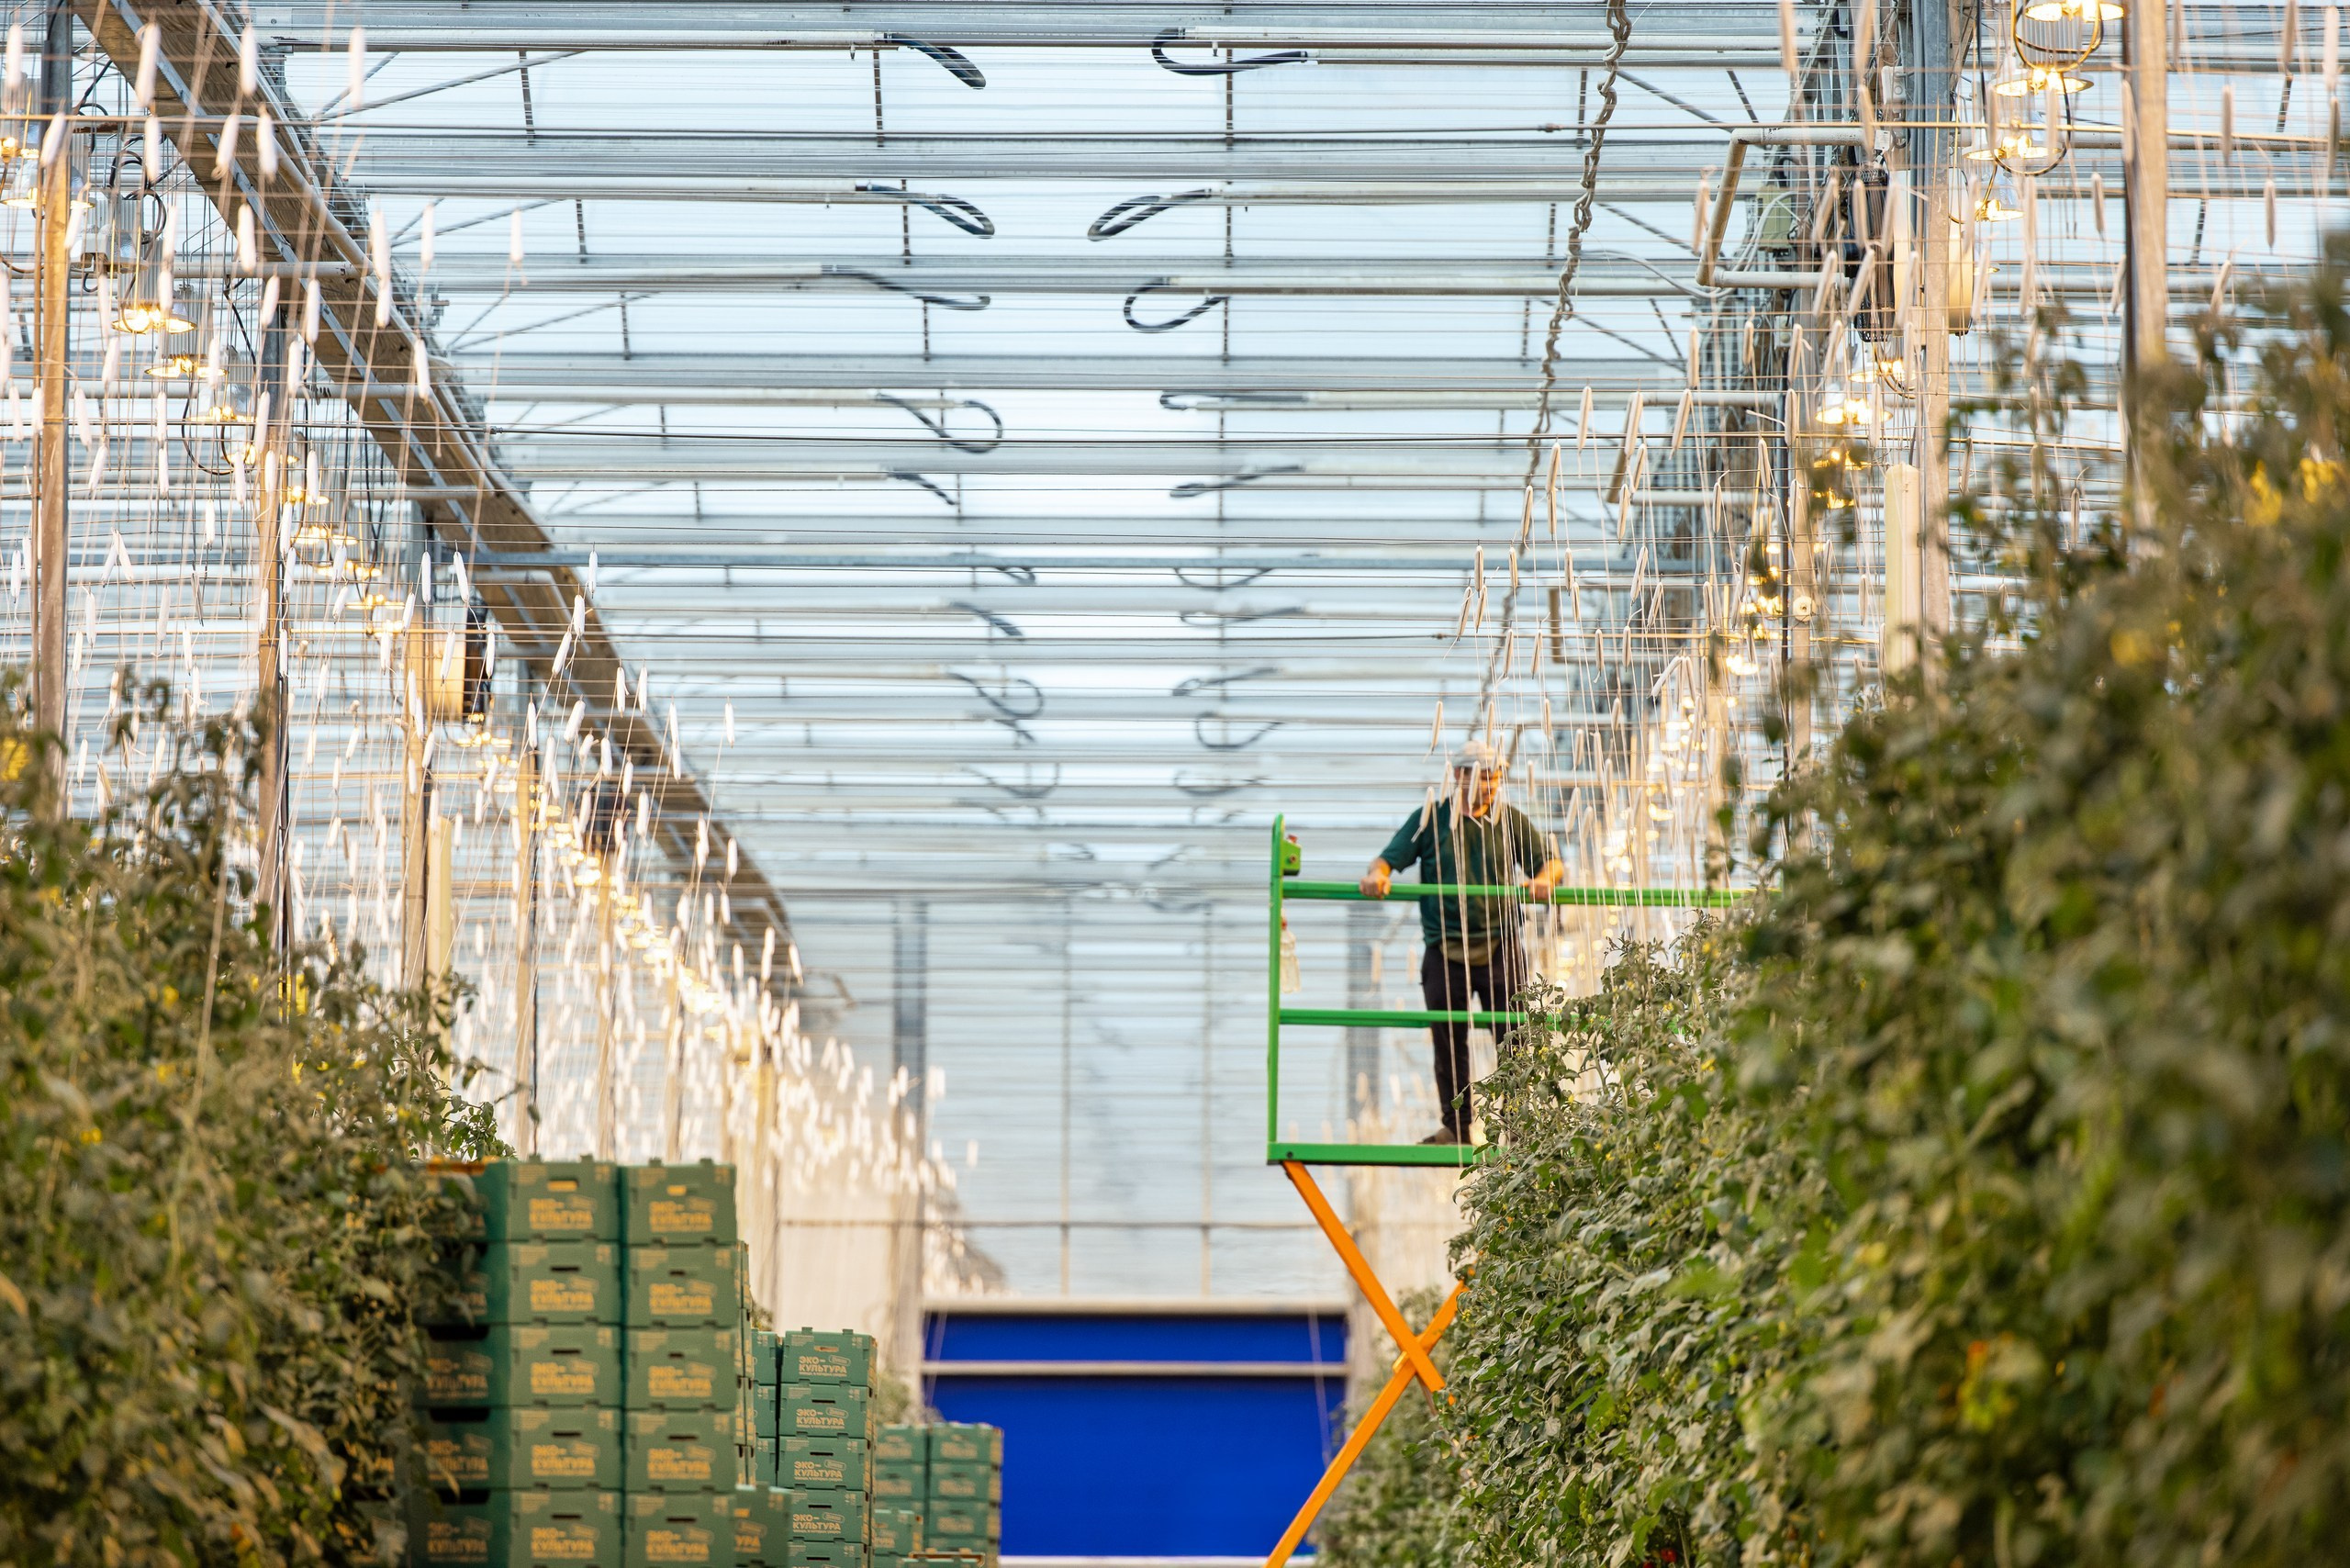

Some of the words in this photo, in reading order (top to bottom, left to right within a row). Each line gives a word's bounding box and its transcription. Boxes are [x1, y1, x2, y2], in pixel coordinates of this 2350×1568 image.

[799, 1356, 826, 1364] ЭКО-
[799, 1364, 847, 1373] КУЛЬТУРА
[796, 1408, 823, 1417] ЭКО-
[796, 1417, 845, 1426] КУЛЬТУРА
[794, 1461, 822, 1469] ЭКО-
[794, 1469, 843, 1478] КУЛЬТУРА
[792, 1521, 841, 1530] КУЛЬТУРА
